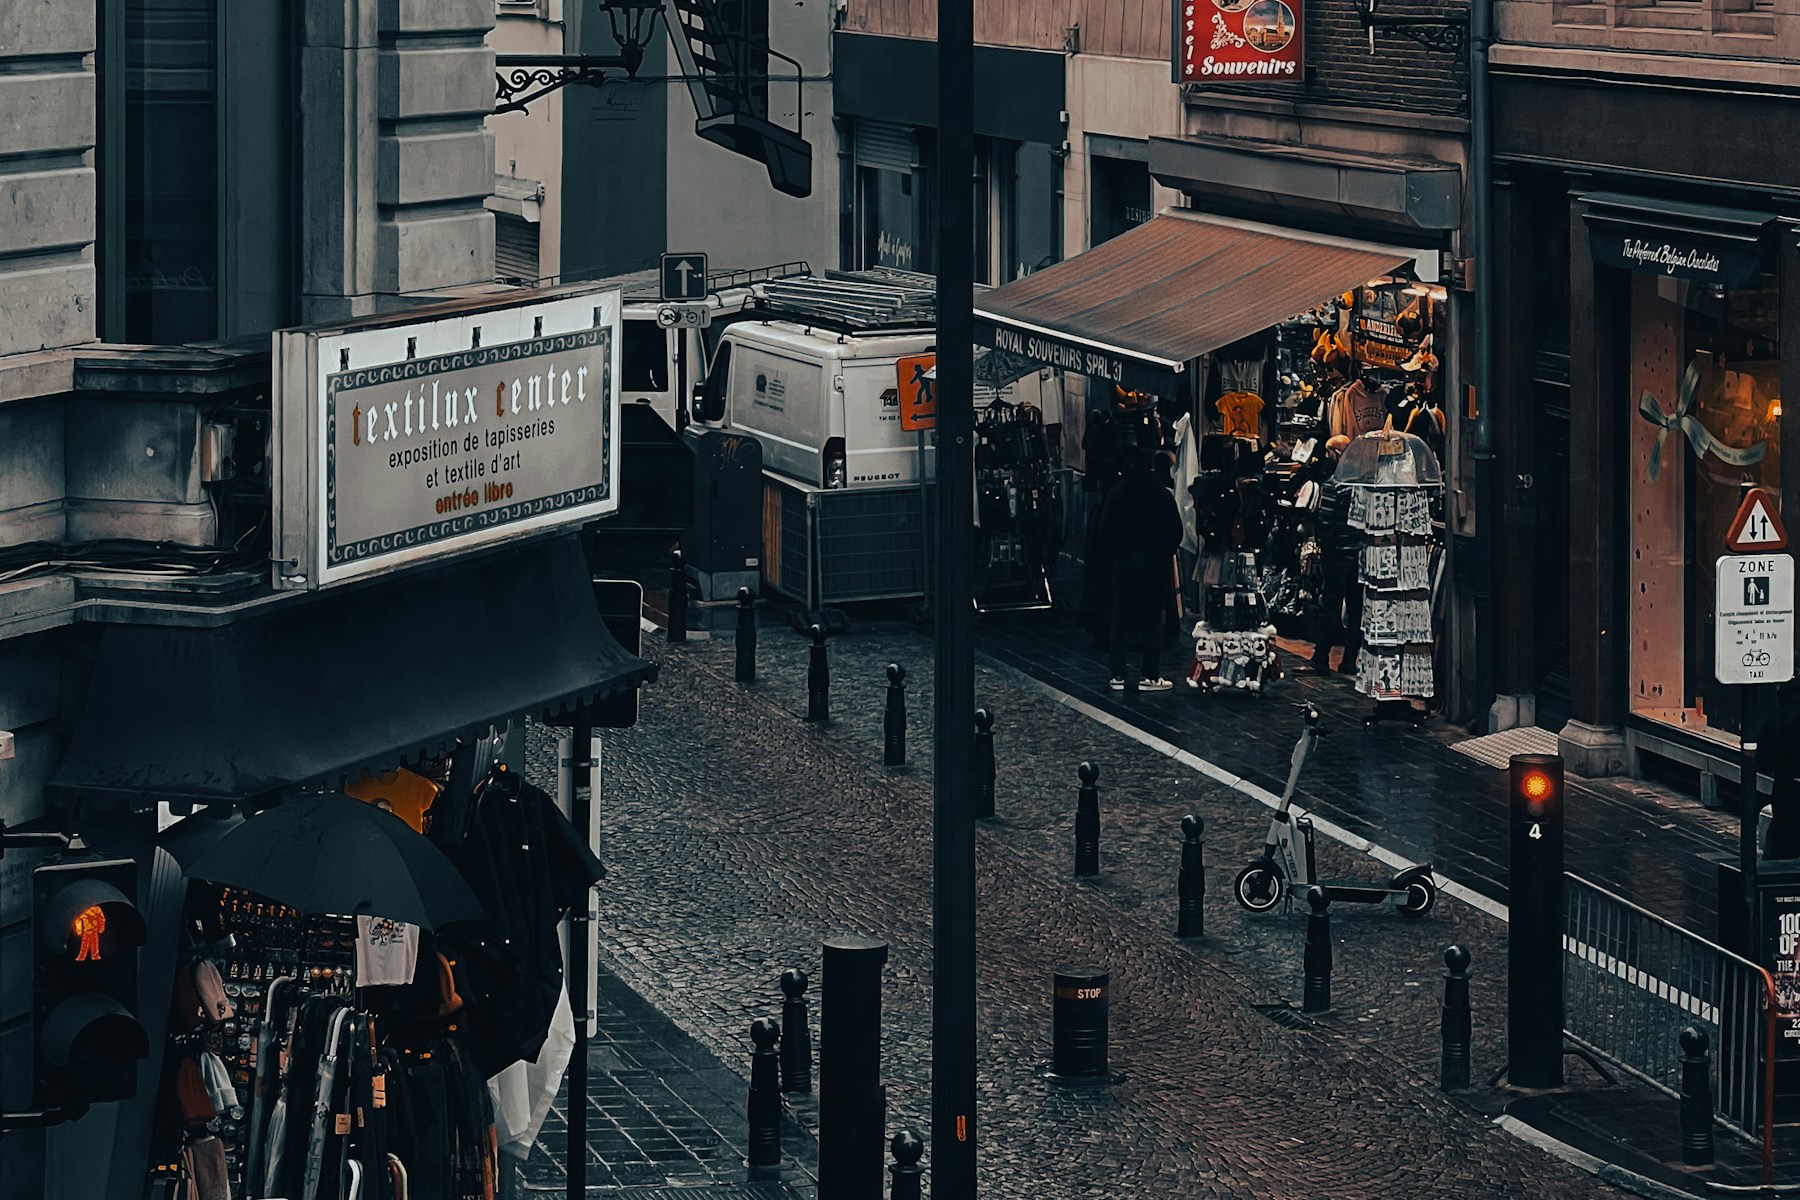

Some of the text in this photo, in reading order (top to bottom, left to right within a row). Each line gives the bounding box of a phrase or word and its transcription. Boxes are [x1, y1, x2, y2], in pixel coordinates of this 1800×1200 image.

[1200, 55, 1296, 76] Souvenirs
[1622, 239, 1633, 258] The
[1660, 244, 1687, 274] Belgian
[1687, 248, 1720, 272] Chocolates
[995, 327, 1123, 382] ROYAL SOUVENIRS SPRL 31
[351, 378, 479, 448] textilux
[388, 418, 556, 469] exposition de tapisseries
[426, 450, 522, 489] et textile d'art
[853, 472, 900, 481] PEUGEOT
[1738, 560, 1775, 573] ZONE
[1528, 823, 1542, 839] 4
[1286, 850, 1298, 879] TIER
[1779, 933, 1800, 955] OF
[1776, 960, 1793, 972] THE
[1077, 987, 1101, 999] STOP
